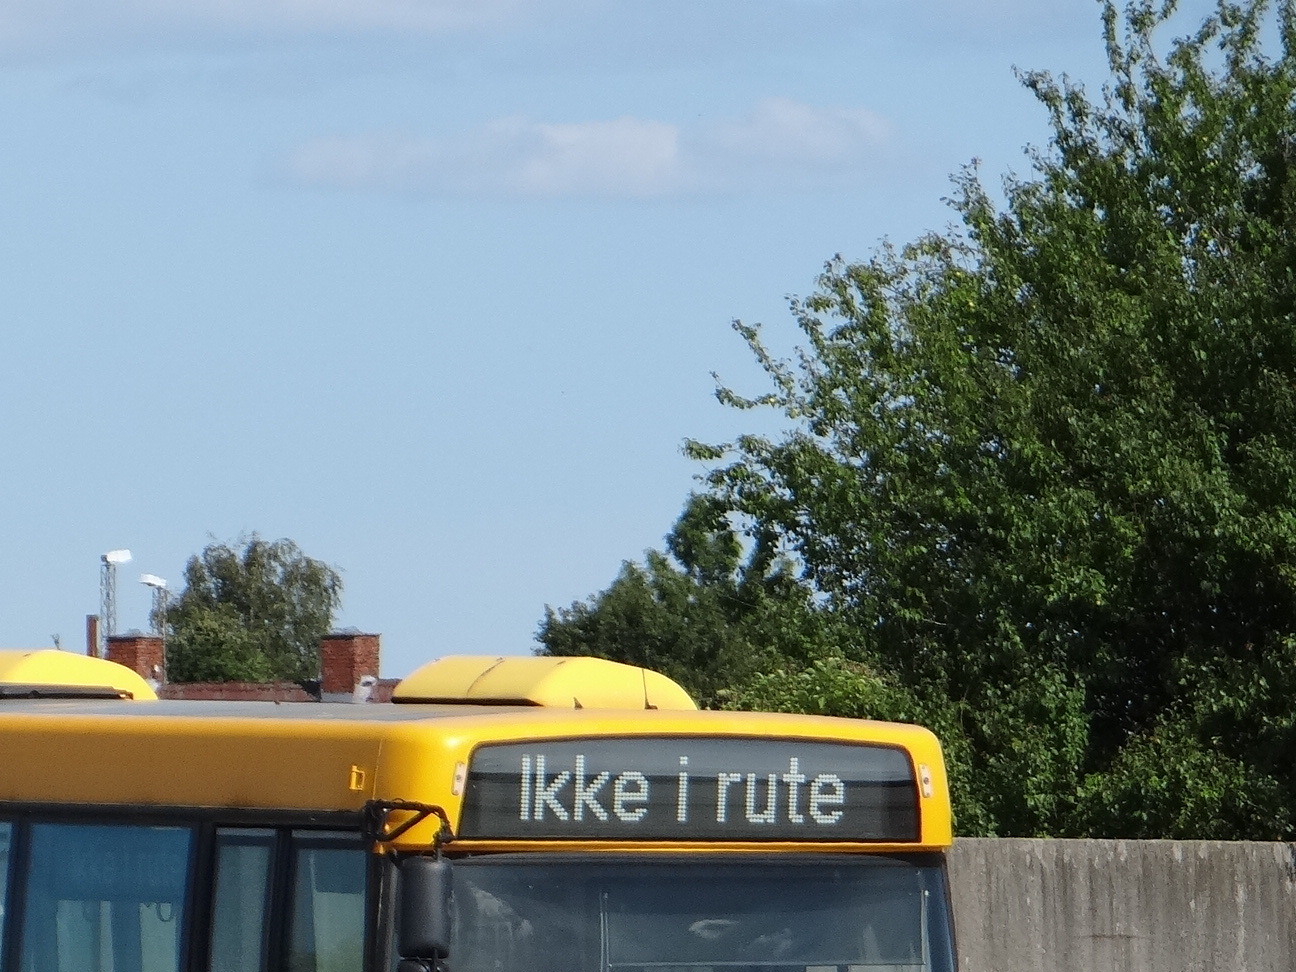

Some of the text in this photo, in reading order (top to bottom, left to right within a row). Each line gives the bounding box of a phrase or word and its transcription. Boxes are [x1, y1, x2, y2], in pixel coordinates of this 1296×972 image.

[519, 754, 845, 824] Ikke i rute
